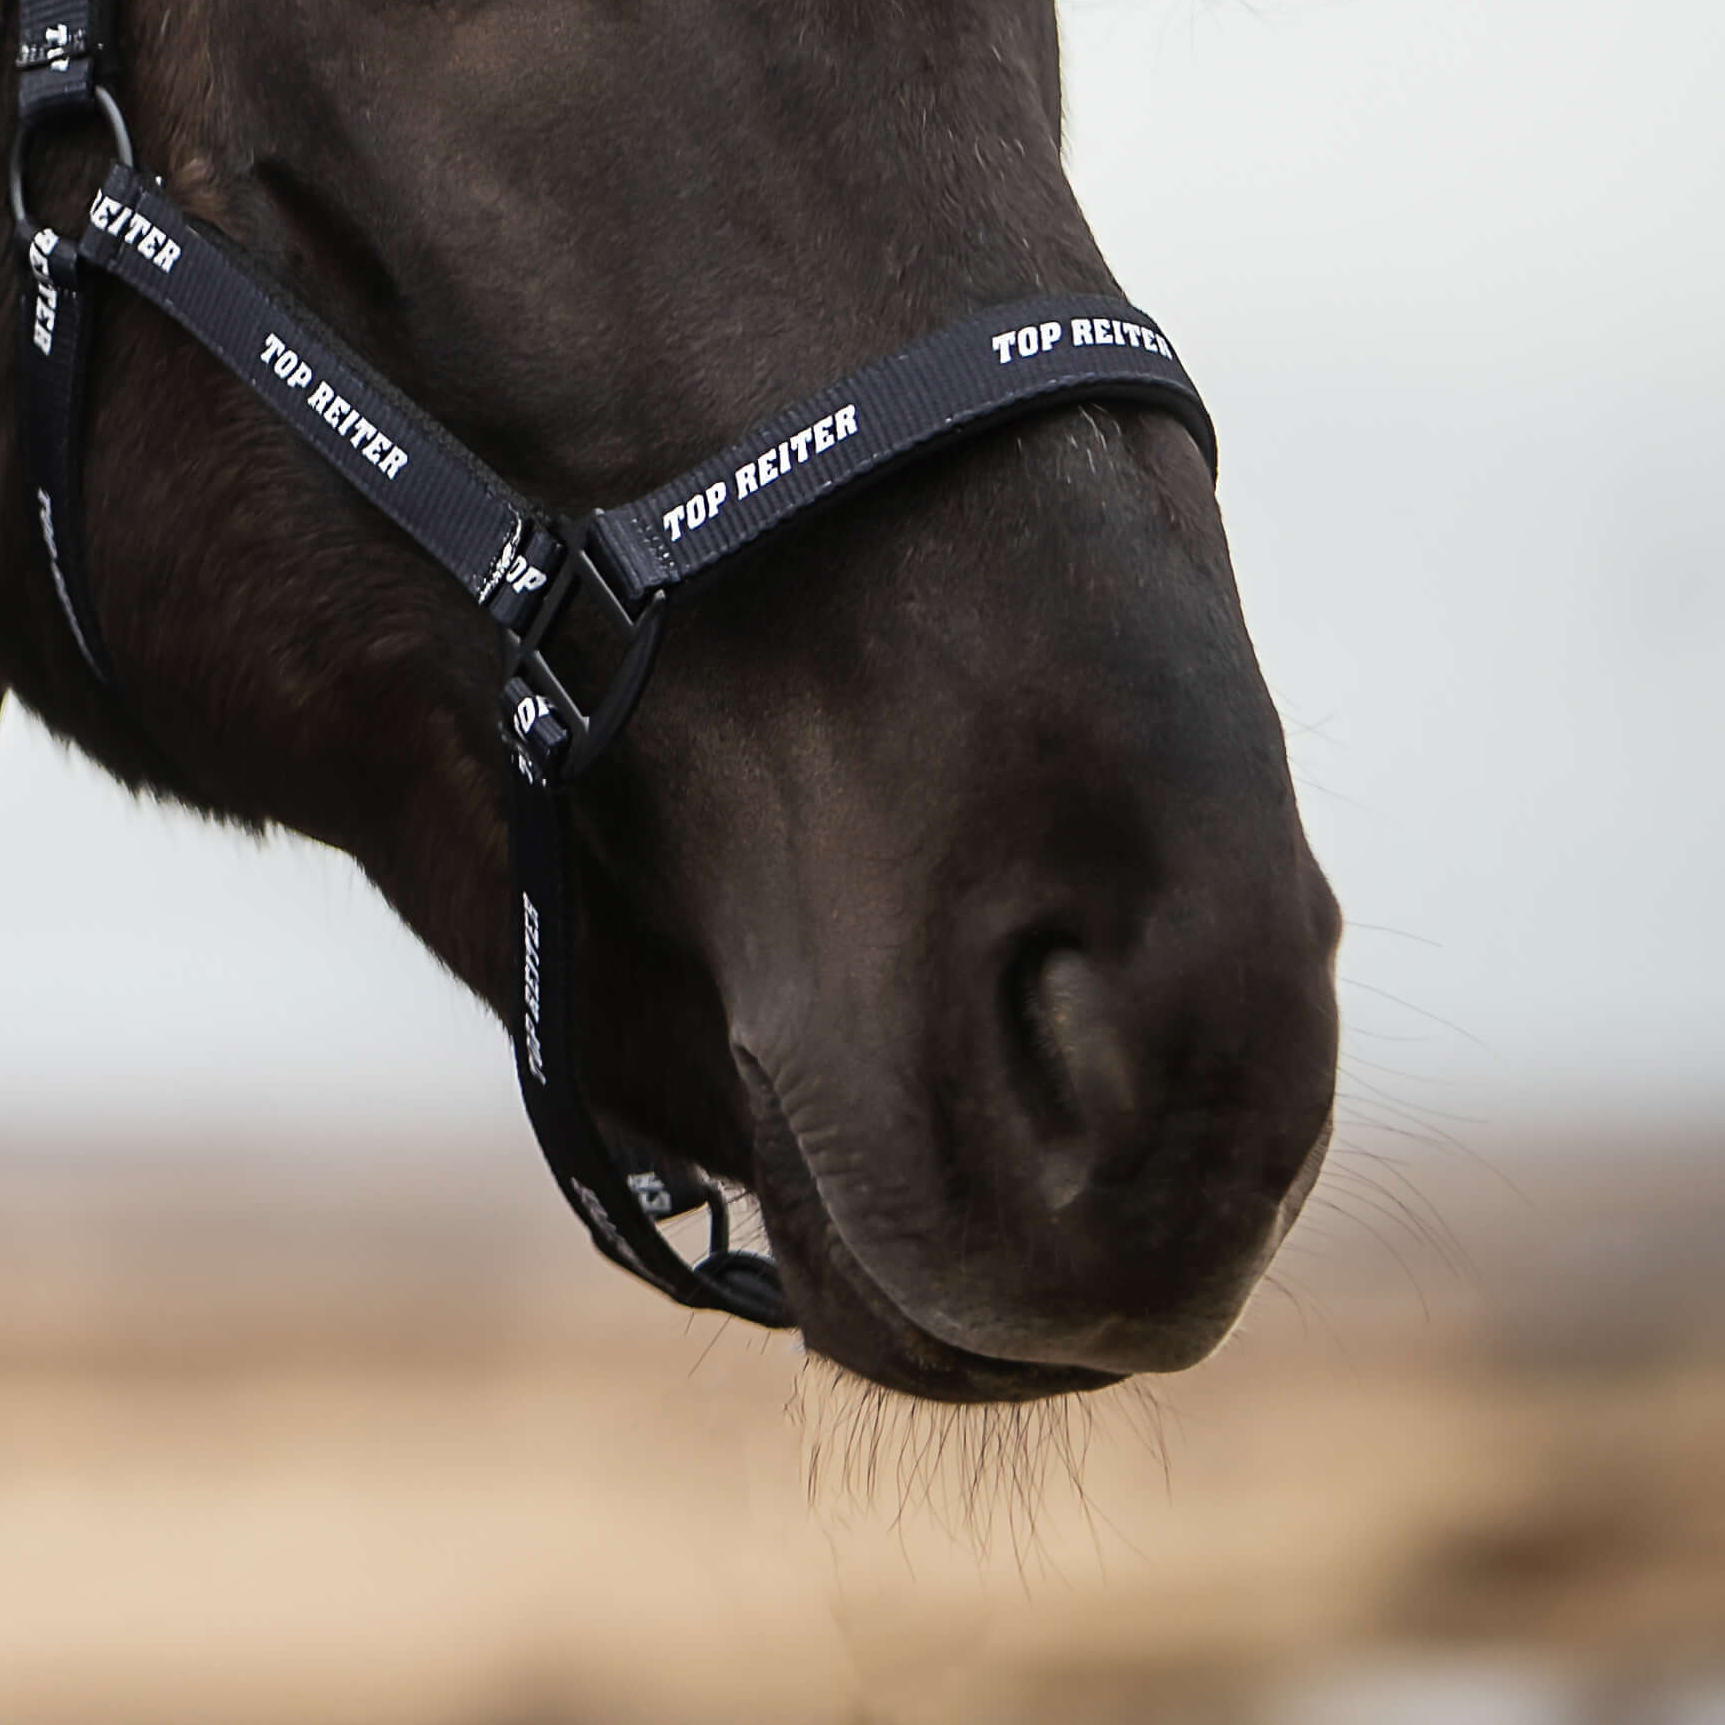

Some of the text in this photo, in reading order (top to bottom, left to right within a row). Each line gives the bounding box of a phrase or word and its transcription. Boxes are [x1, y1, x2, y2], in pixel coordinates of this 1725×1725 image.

[260, 332, 408, 480] TOP REITER
[991, 321, 1062, 364] TOP
[662, 404, 858, 542] TOP REITER
